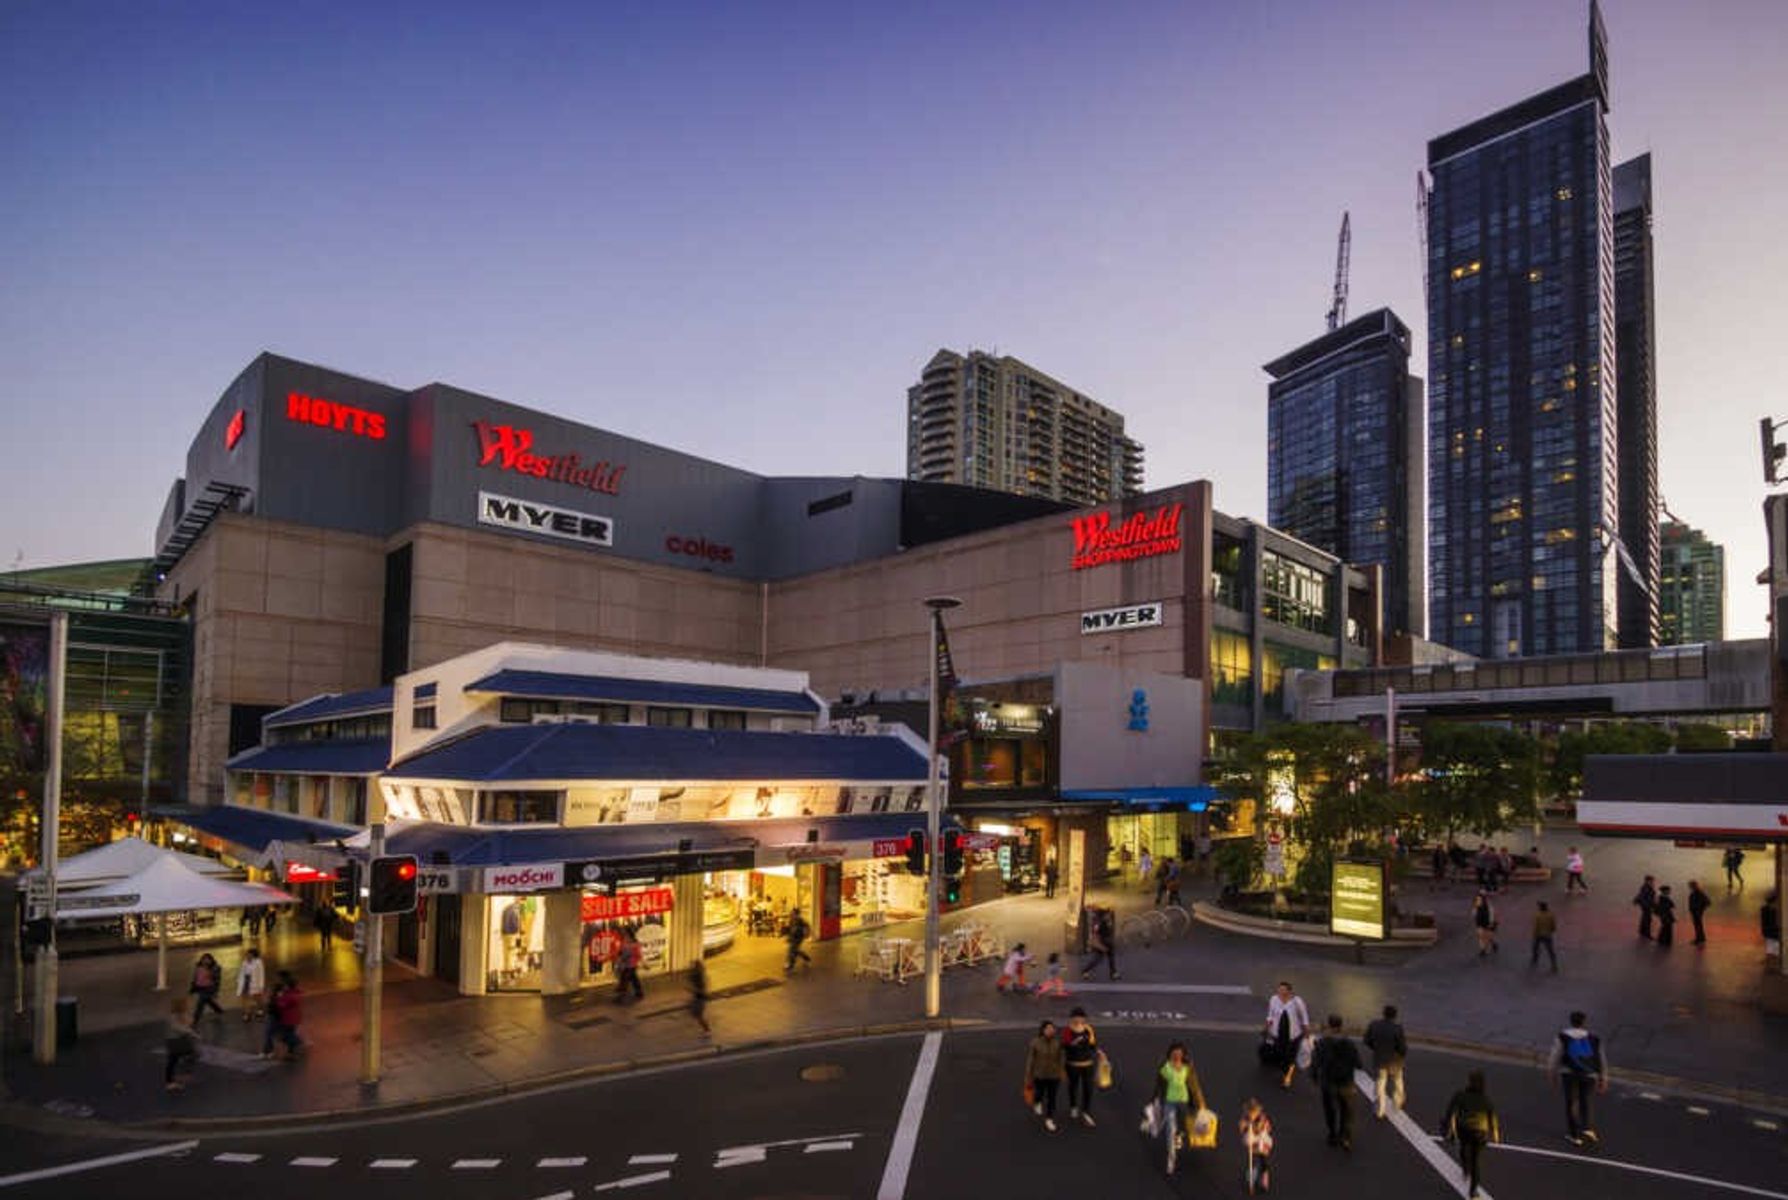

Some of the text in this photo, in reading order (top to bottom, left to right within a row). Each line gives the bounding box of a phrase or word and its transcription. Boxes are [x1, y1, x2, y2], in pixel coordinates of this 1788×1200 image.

[287, 391, 386, 440] HOYTS
[473, 419, 627, 496] Westfield
[487, 498, 609, 542] MYER
[1070, 501, 1183, 552] Westfield
[664, 534, 735, 564] coles
[1071, 538, 1182, 570] SHOPPINGTOWN
[1082, 607, 1156, 630] MYER
[628, 892, 670, 914] SALE
